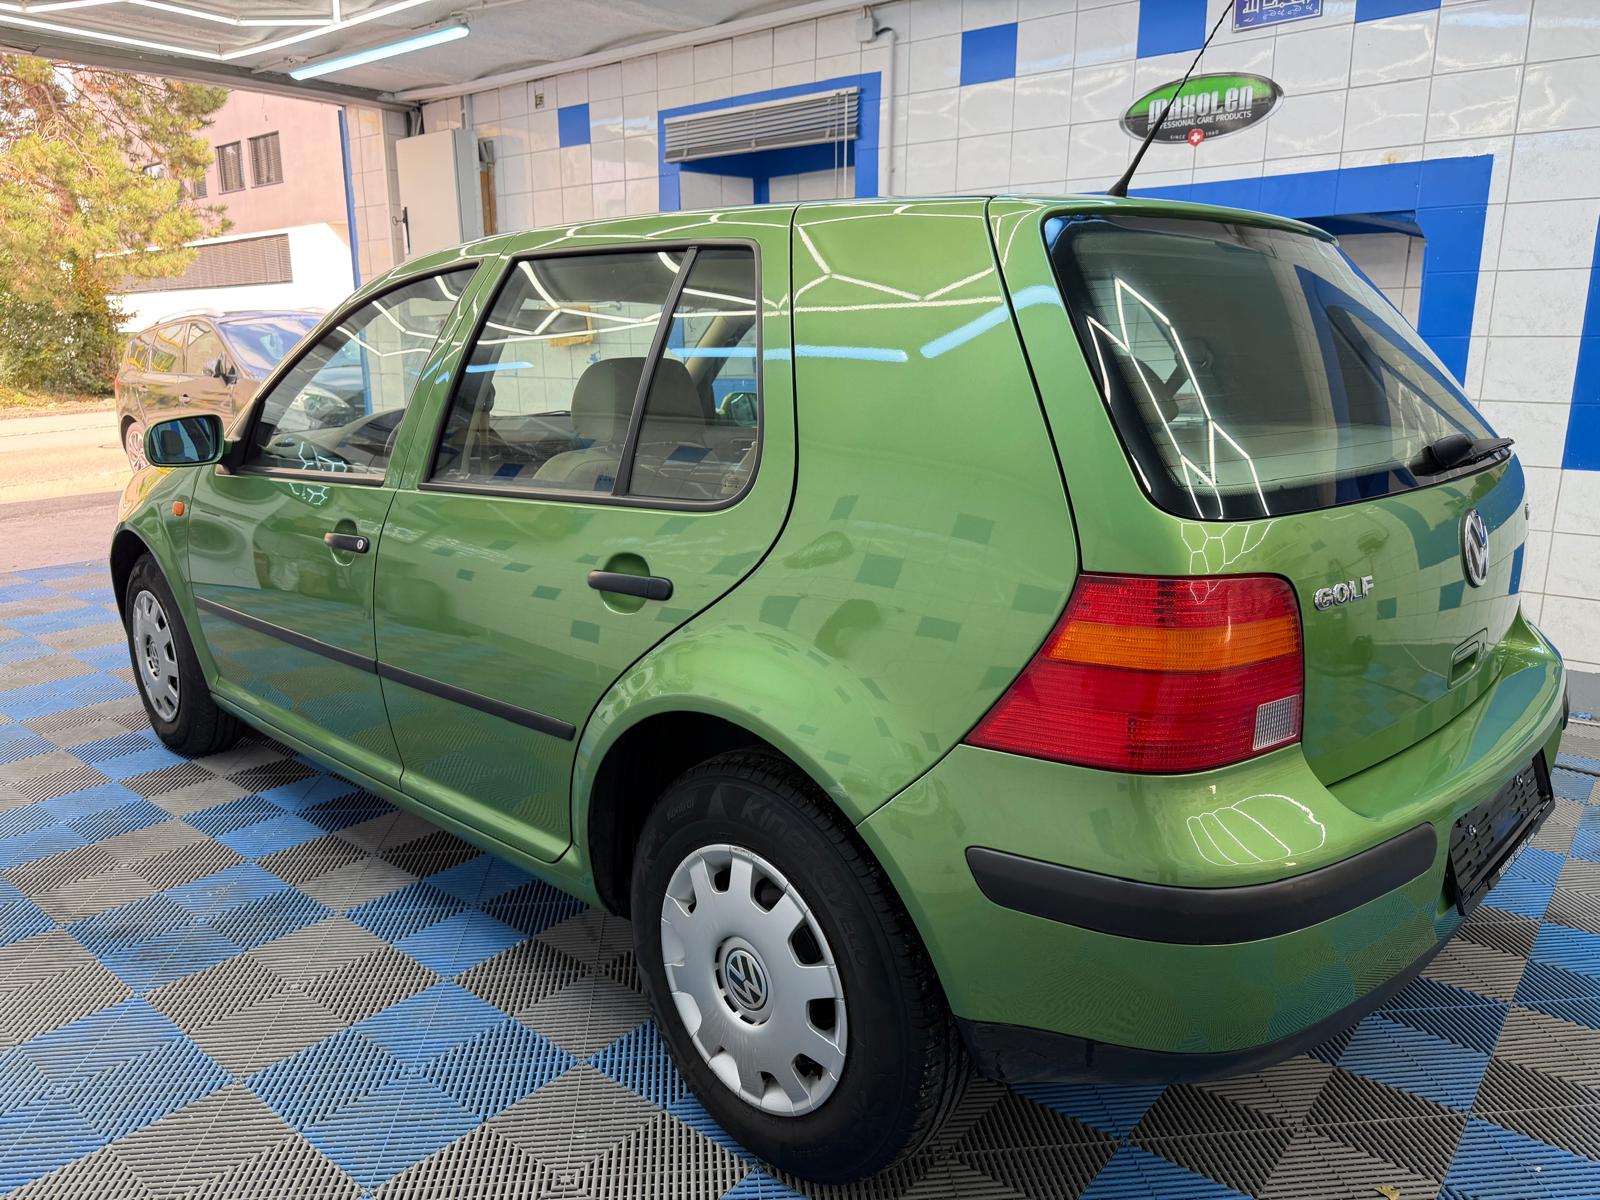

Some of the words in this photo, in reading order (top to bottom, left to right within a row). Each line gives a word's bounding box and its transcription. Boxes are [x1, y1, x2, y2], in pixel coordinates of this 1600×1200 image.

[1197, 116, 1214, 125] CARE
[1215, 110, 1252, 122] PRODUCTS
[1314, 575, 1375, 611] GOLF
